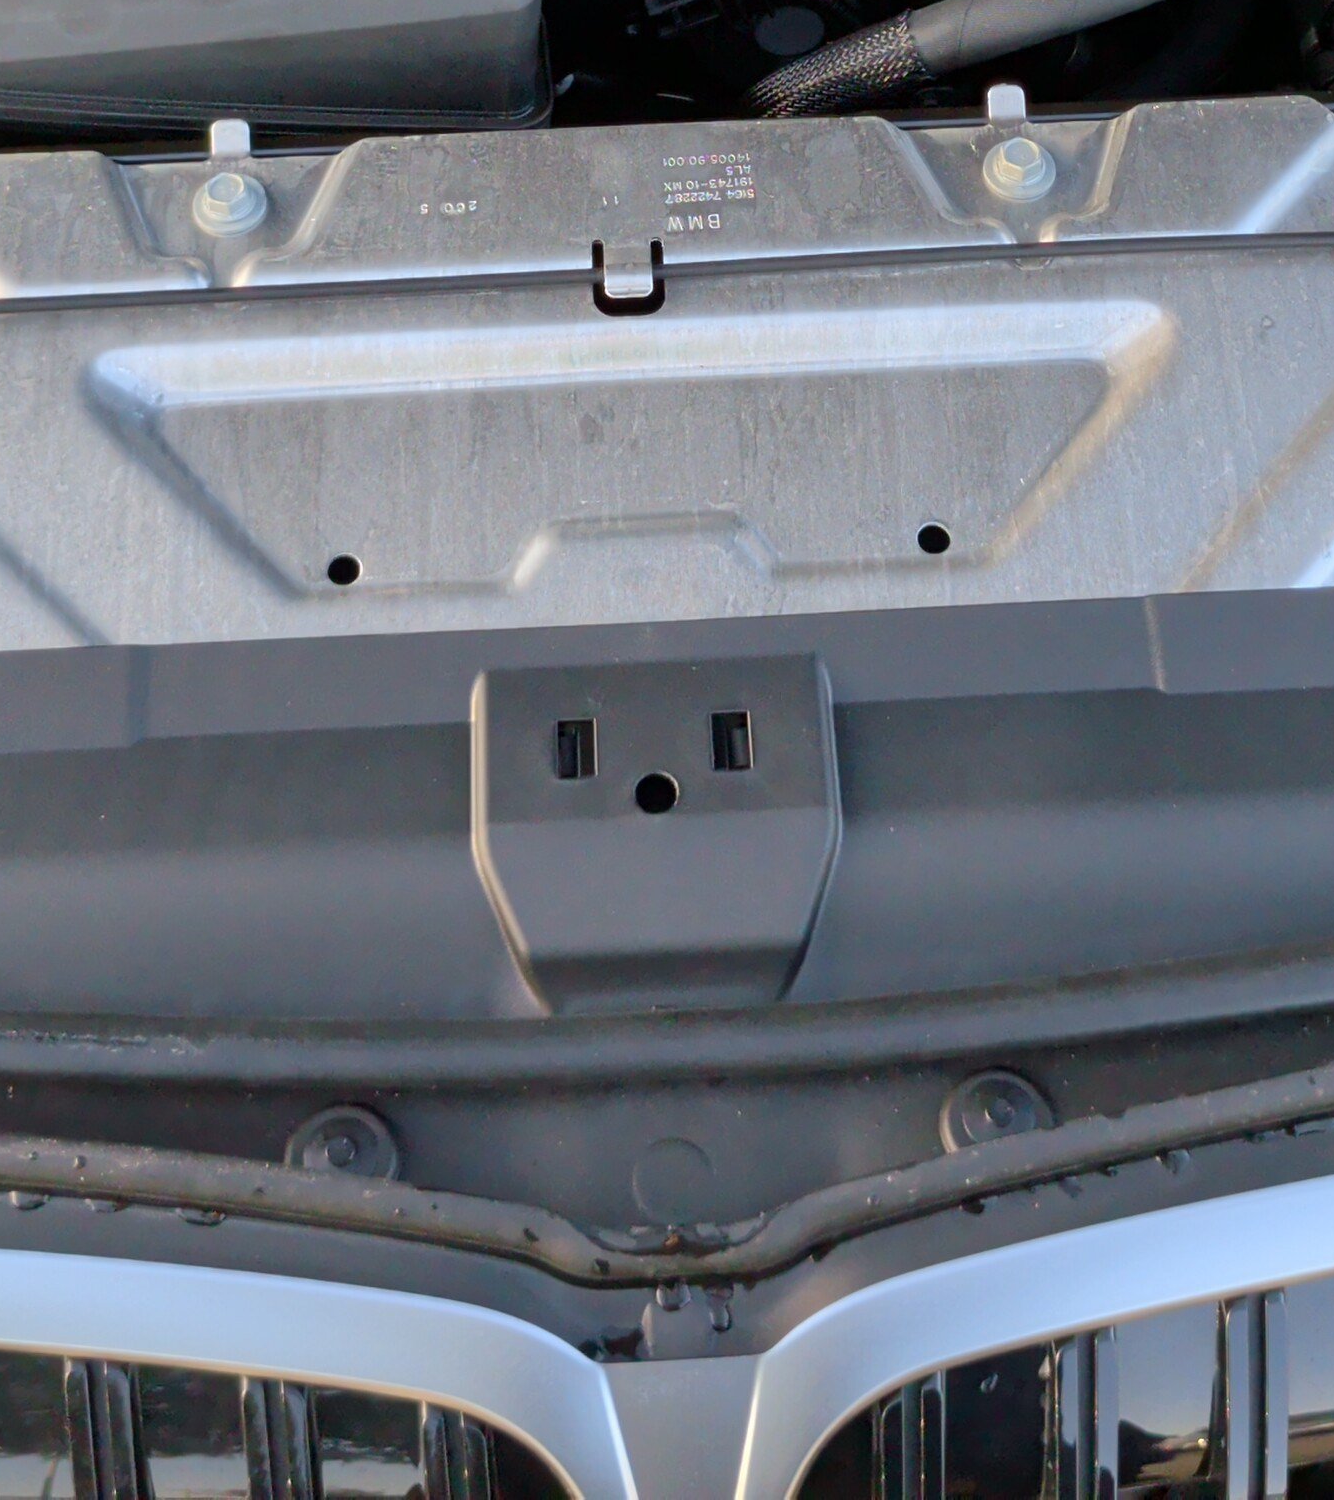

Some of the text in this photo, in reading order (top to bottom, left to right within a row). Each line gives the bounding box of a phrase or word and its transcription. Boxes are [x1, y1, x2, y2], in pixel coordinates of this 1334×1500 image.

[663, 177, 754, 191] 191743-10 MX
[664, 188, 755, 204] 5164 7422287
[666, 213, 721, 232] BMW
